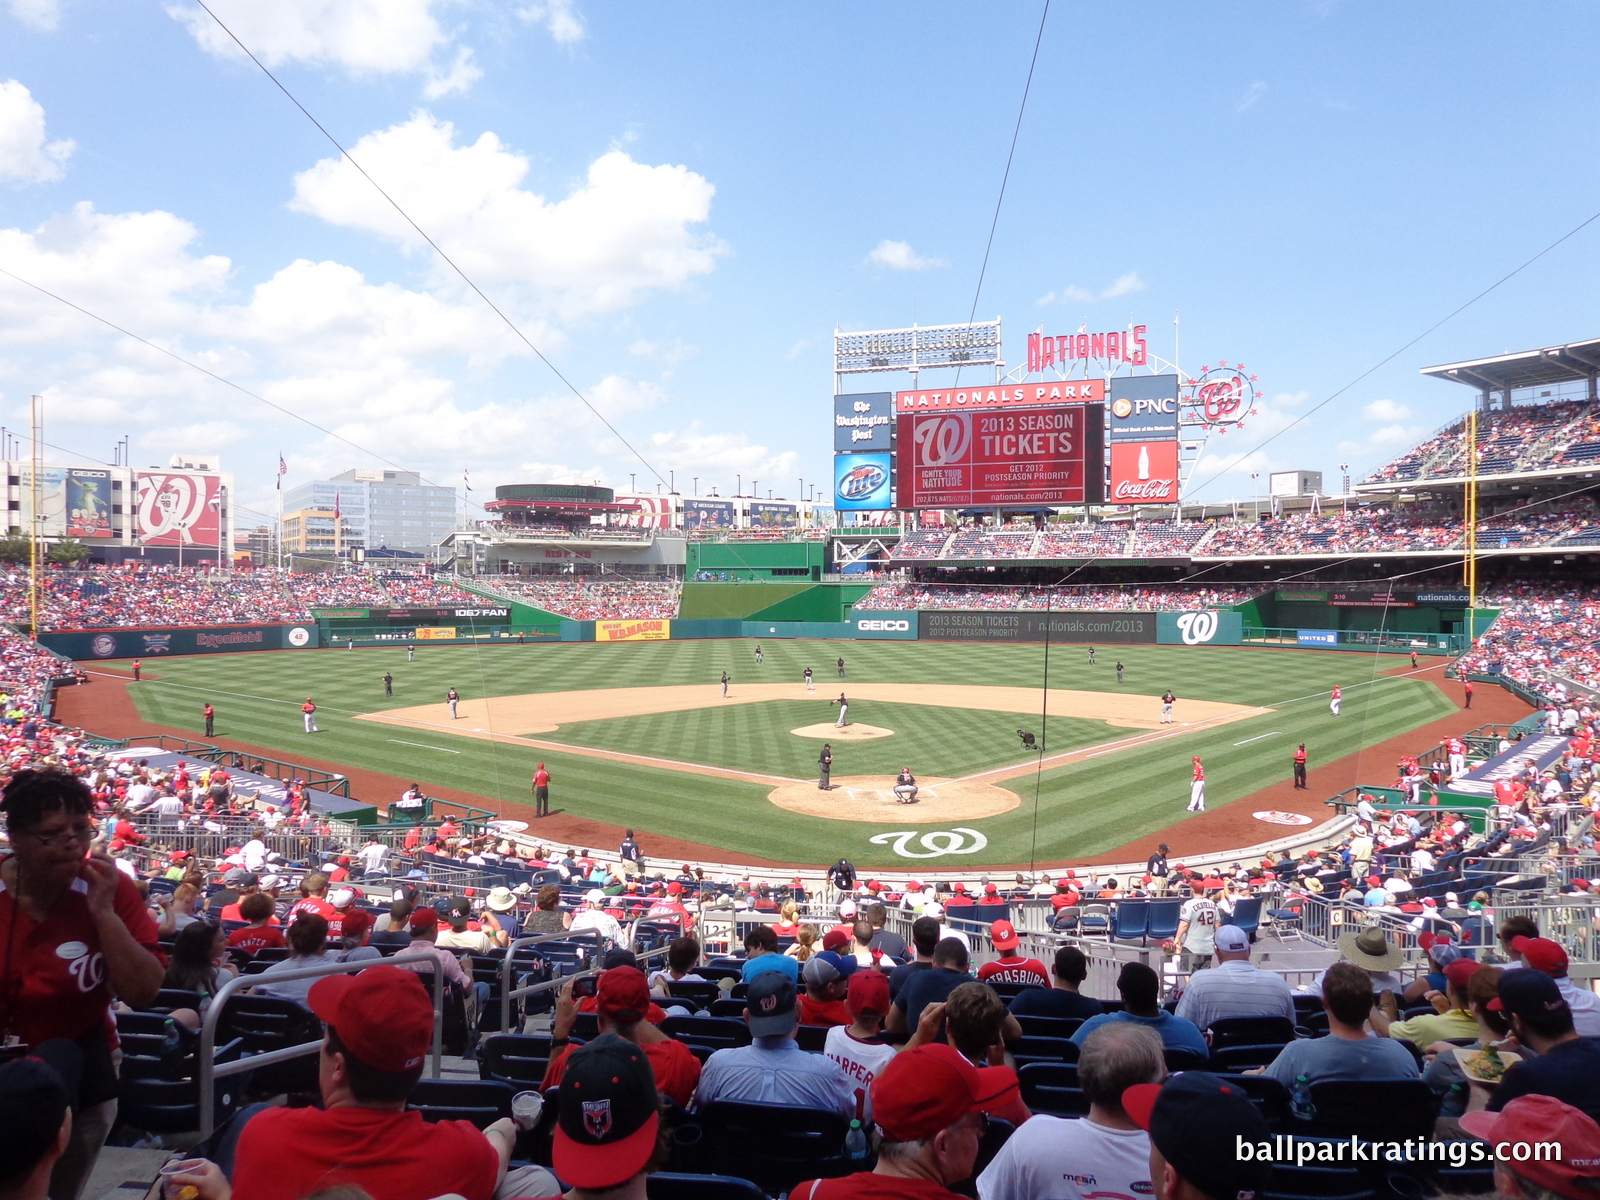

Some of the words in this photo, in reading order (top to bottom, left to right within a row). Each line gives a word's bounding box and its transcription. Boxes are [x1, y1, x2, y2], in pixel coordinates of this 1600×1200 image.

[1027, 325, 1147, 373] NATIONALS
[903, 388, 1024, 408] NATIONALS
[1036, 384, 1093, 400] PARK
[853, 400, 871, 413] The
[1134, 397, 1175, 415] PNC
[836, 414, 889, 428] Washington
[980, 416, 1015, 433] 2013
[1018, 413, 1074, 432] SEASON
[851, 429, 873, 443] Post
[980, 431, 1073, 457] TICKETS
[922, 469, 943, 479] IGNITE
[944, 468, 962, 478] YOUR
[1009, 464, 1024, 473] GET
[1025, 464, 1044, 472] 2012
[922, 476, 963, 489] NATITUDE
[985, 472, 1032, 482] POSTSEASON
[1035, 471, 1070, 480] PRIORITY
[1115, 478, 1174, 500] Coca-Cola
[990, 491, 1063, 502] nationals.com/2013
[482, 608, 508, 616] FAN
[857, 619, 910, 631] GEICO
[929, 614, 950, 626] 2013
[951, 614, 984, 627] SEASON
[985, 615, 1019, 628] TICKETS
[196, 630, 263, 648] ExxonMobil
[929, 627, 946, 636] 2012
[946, 627, 988, 637] POSTSEASON
[988, 628, 1019, 638] PRIORITY
[1197, 910, 1214, 926] 42
[1333, 913, 1341, 923] C
[704, 924, 728, 938] 121
